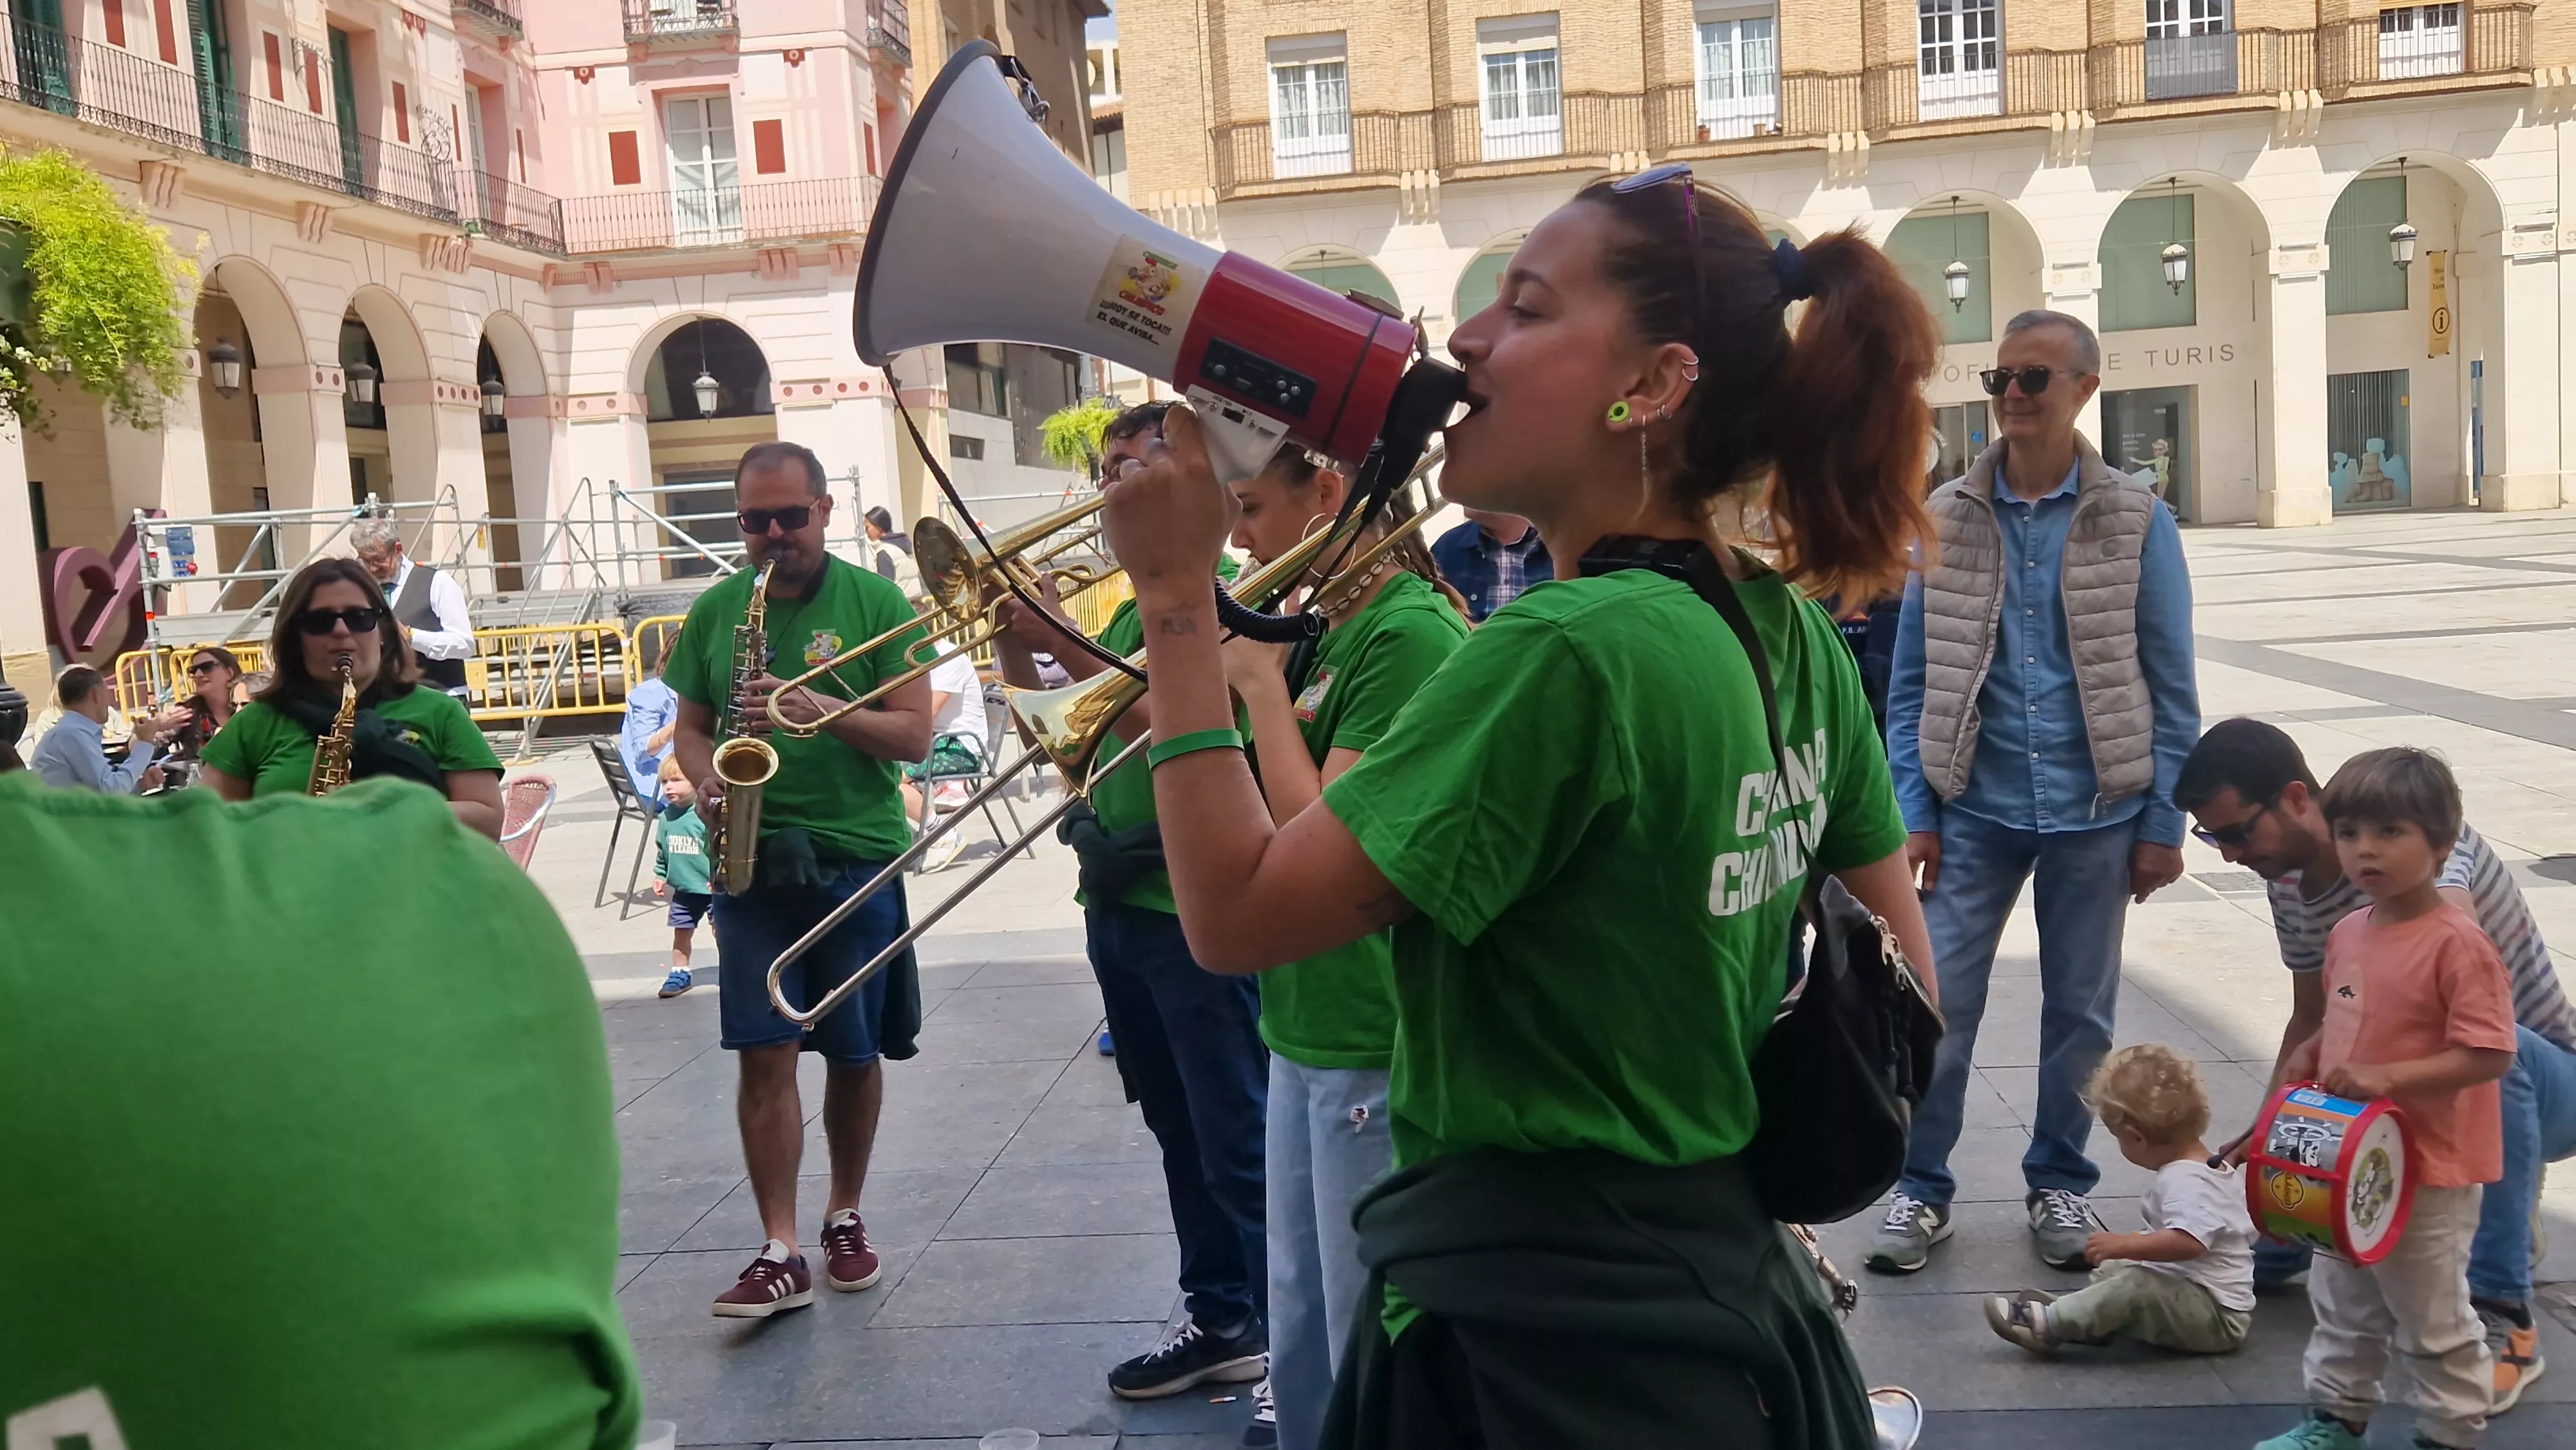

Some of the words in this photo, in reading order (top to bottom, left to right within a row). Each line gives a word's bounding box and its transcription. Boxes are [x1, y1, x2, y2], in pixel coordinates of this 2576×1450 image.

[1097, 312, 1106, 322] EL
[1109, 316, 1128, 330] QUE
[1128, 310, 1141, 321] SE
[2107, 352, 2121, 371] E
